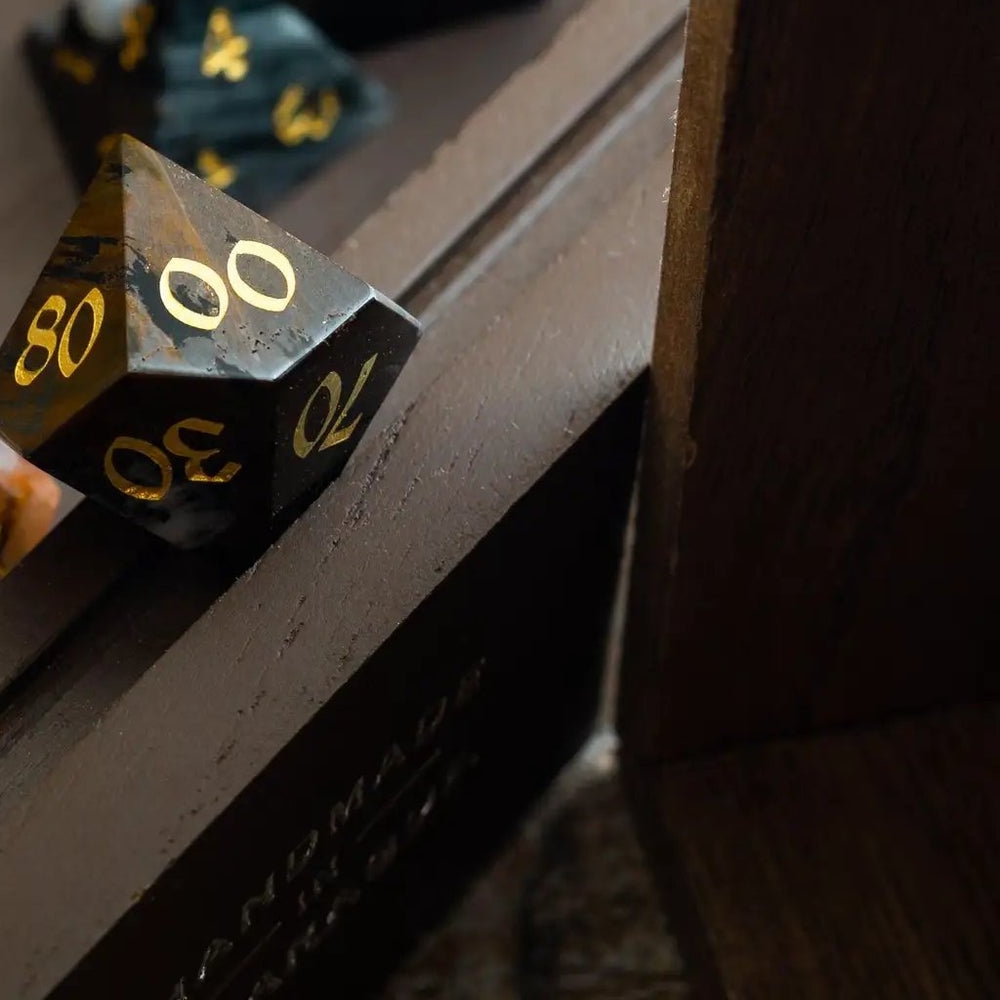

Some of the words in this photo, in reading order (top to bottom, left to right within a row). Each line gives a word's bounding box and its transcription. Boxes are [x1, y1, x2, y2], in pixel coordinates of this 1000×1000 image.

[158, 239, 297, 331] 00
[13, 287, 105, 386] 80
[292, 352, 379, 459] 70
[104, 416, 242, 501] 30
